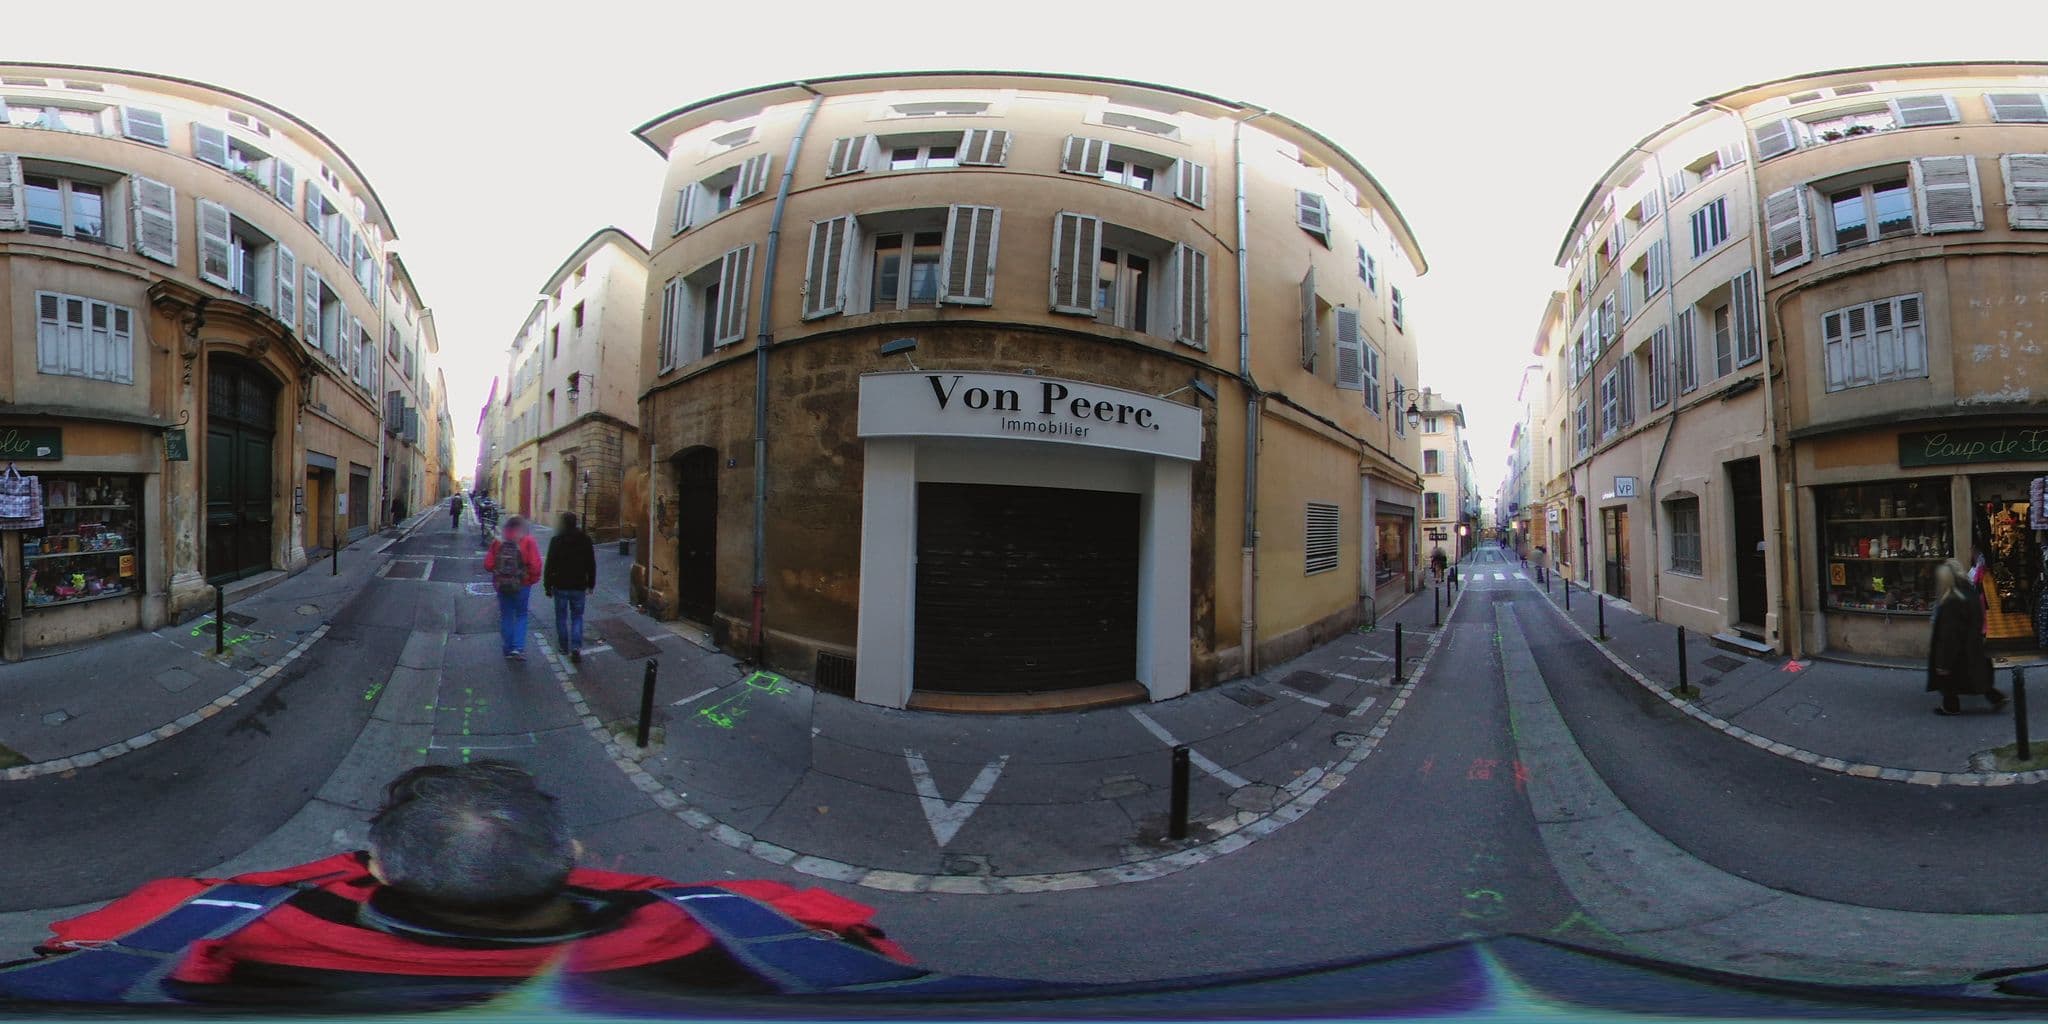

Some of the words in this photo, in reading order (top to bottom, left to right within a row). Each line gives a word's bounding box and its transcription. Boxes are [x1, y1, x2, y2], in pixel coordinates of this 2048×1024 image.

[925, 375, 1021, 411] Von
[1039, 381, 1160, 431] Peerc.
[1001, 417, 1090, 437] Immobilier
[1925, 433, 1985, 459] Coup
[1990, 431, 2018, 454] de
[1618, 484, 1632, 495] VP
